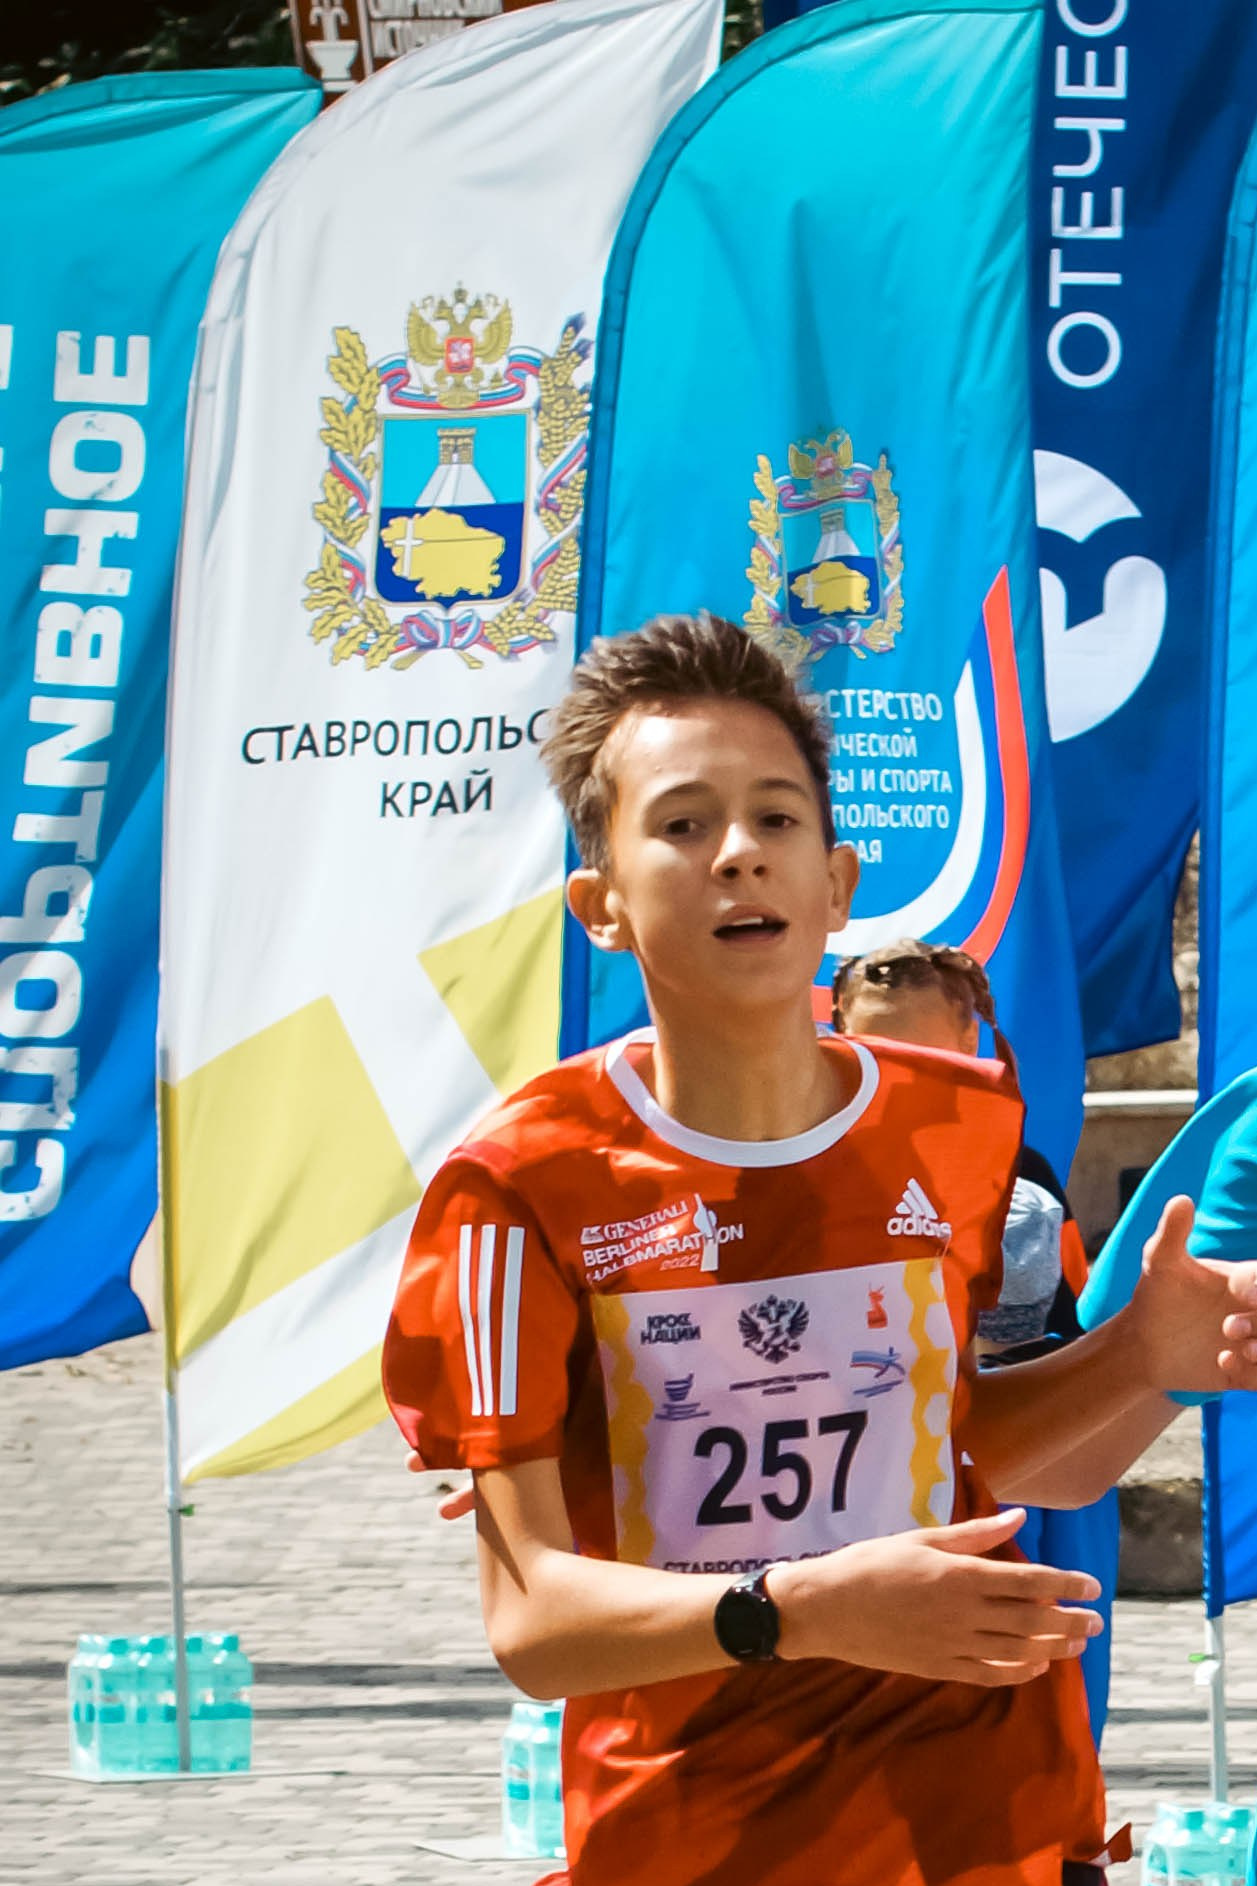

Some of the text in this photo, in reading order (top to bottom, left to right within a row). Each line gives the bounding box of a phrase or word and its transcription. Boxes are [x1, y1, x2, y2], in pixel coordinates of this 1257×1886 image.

[1047, 0, 1129, 388] ОТЕЧЕС
[825, 689, 943, 721] СТЕРСТВО
[242, 708, 557, 765] СТАВРОПОЛЬС
[831, 727, 917, 758] ЧЕСКОЙ
[379, 768, 493, 818] КРАЙ
[860, 769, 875, 792] И
[879, 768, 953, 794] СПОРТА
[832, 803, 949, 829] ПОЛЬСКОГО
[602, 1200, 690, 1241] GENERALI
[582, 1223, 678, 1268] BERLINER
[694, 1409, 868, 1527] 257
